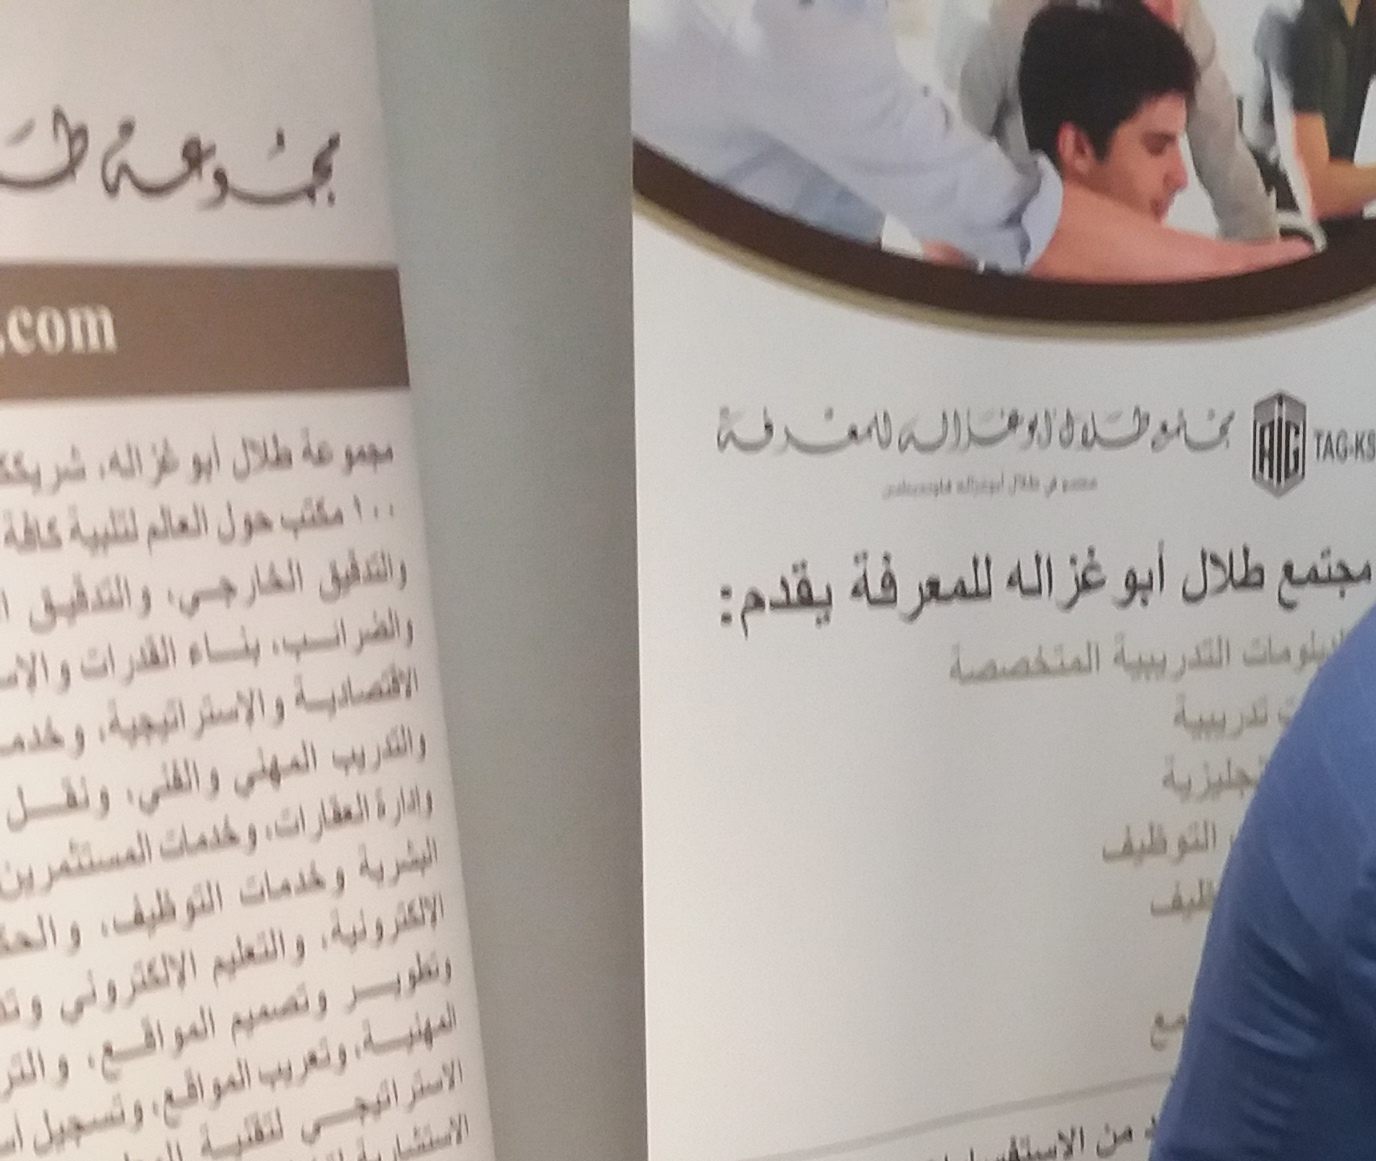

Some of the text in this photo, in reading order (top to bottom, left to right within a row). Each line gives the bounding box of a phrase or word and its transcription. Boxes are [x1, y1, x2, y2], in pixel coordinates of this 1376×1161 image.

[233, 431, 293, 482] طلال
[217, 500, 274, 547] حول
[850, 549, 993, 624] للمعرفة
[1182, 542, 1265, 608] طلال
[1278, 545, 1373, 611] مجتمع
[1096, 1121, 1133, 1159] من
